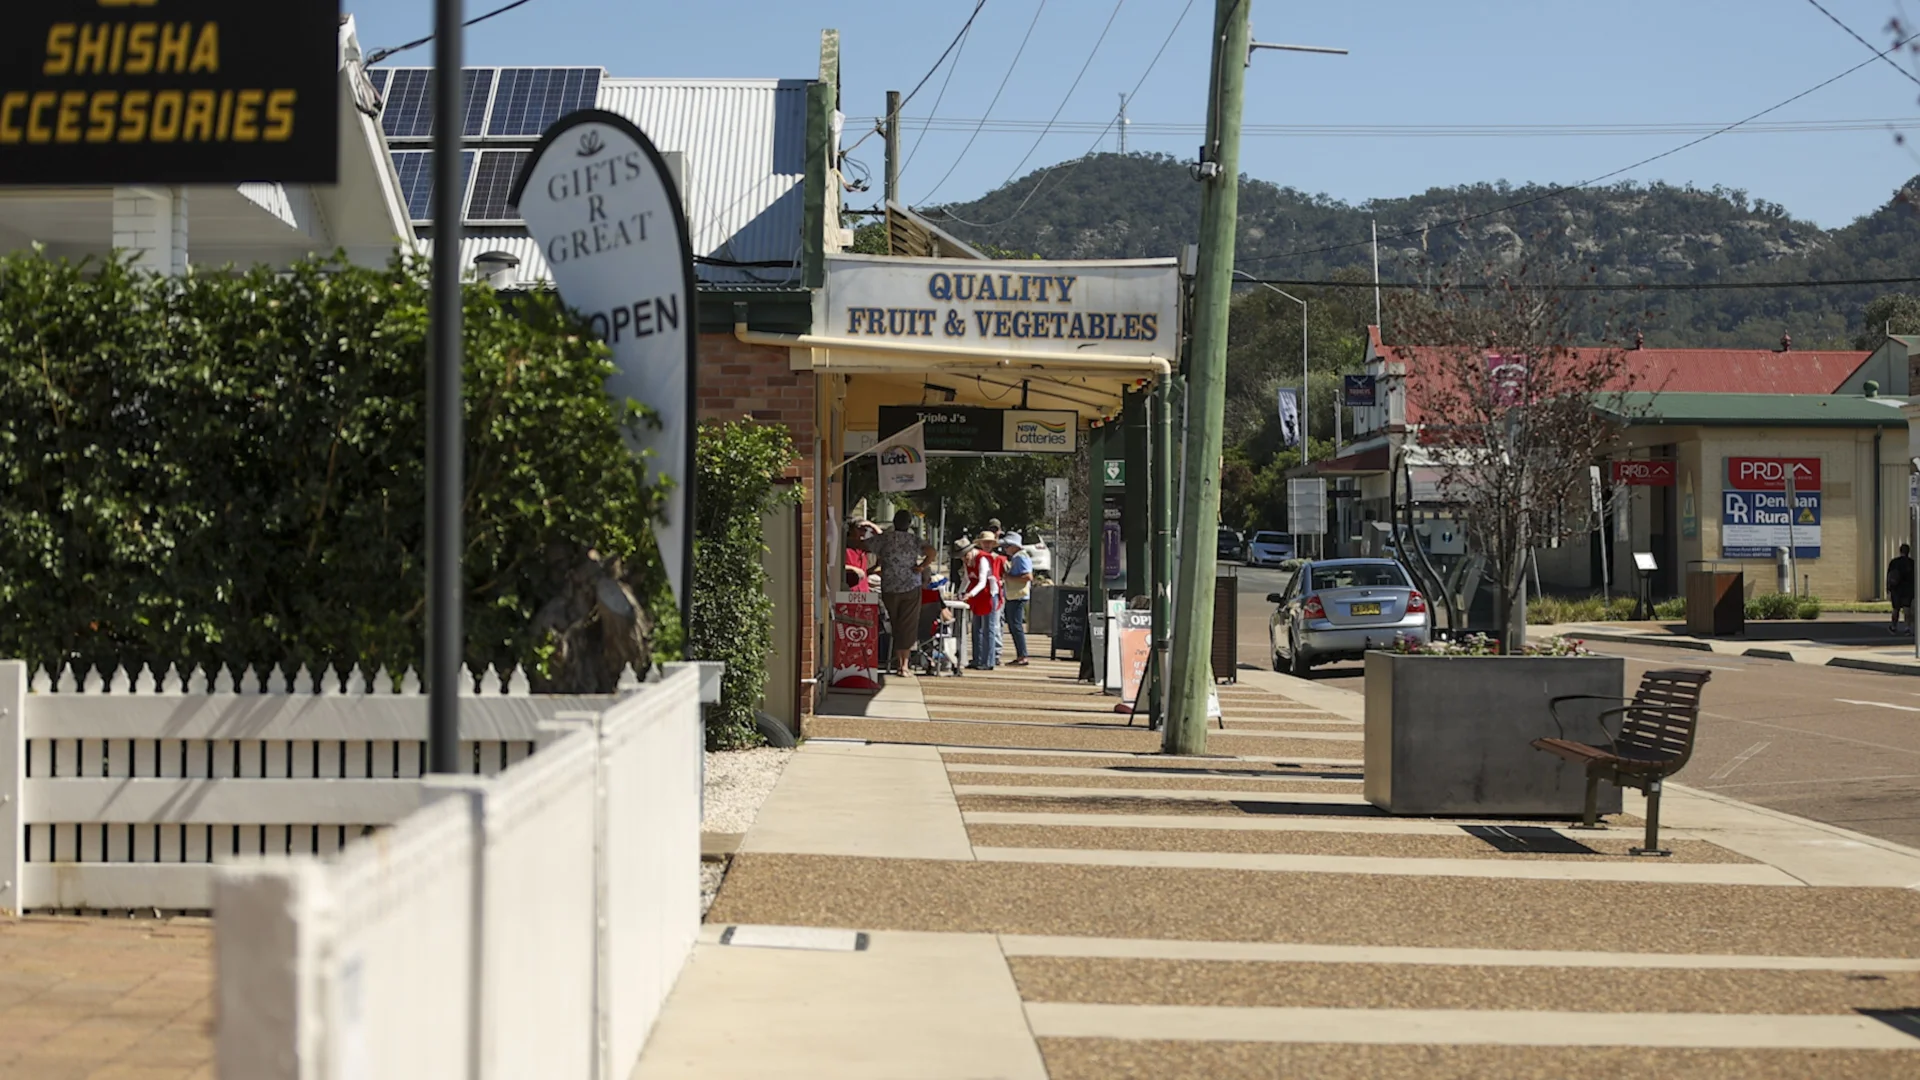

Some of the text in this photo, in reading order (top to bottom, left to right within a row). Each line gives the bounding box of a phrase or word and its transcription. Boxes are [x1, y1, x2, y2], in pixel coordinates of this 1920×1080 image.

[42, 21, 220, 75] SHISHA
[547, 151, 641, 203] GIFTS
[589, 194, 608, 224] R
[547, 211, 653, 265] GREAT
[928, 272, 1077, 302] QUALITY
[847, 307, 1158, 341] FRUIT & VEGETABLES
[916, 412, 967, 423] Triple J's
[1015, 432, 1066, 444] Lotteries
[881, 453, 907, 465] Lott
[1755, 510, 1790, 524] Rura
[848, 593, 867, 603] OPEN
[1131, 615, 1152, 625] OP
